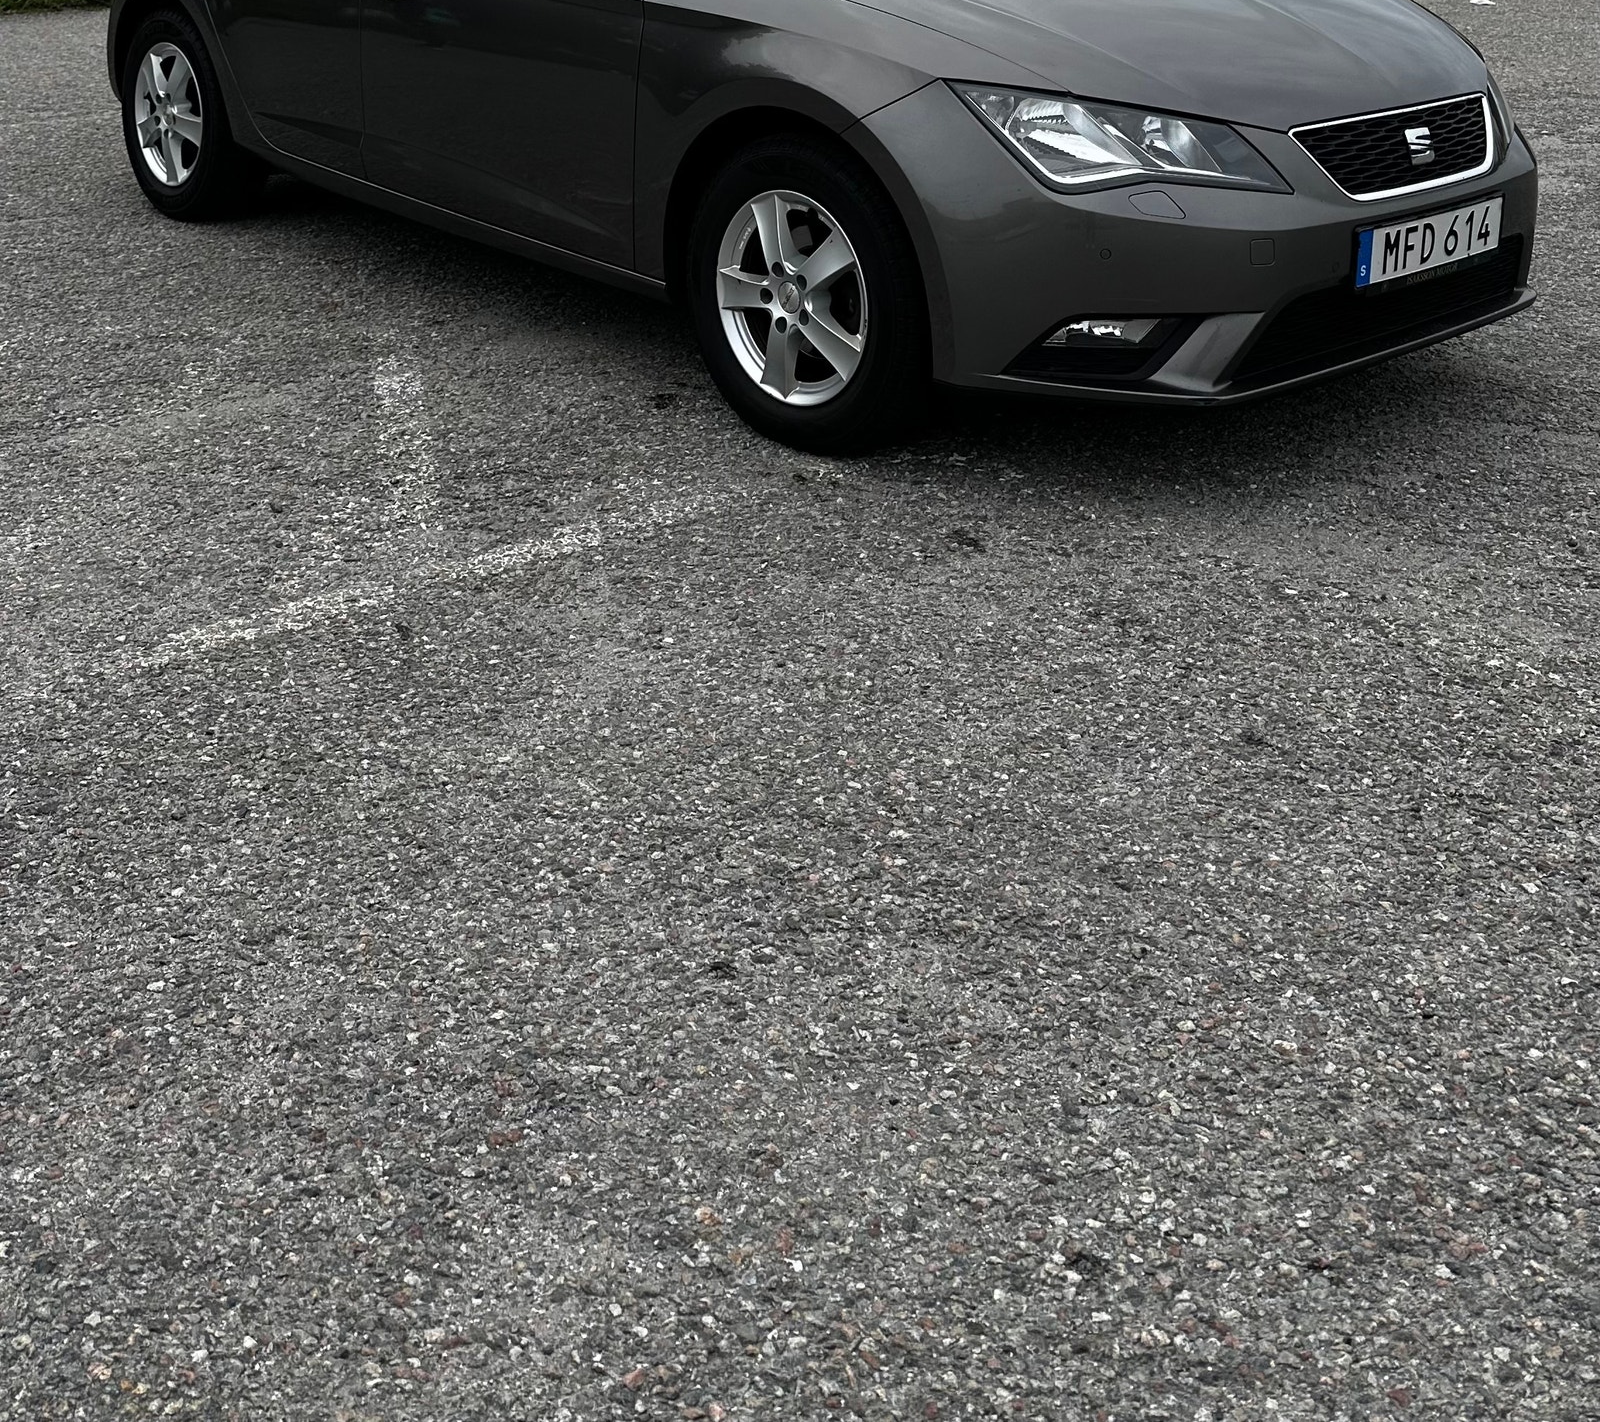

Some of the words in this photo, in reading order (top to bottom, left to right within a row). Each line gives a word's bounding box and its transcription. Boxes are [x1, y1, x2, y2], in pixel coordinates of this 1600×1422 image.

[1382, 222, 1436, 275] MFD
[1444, 205, 1490, 257] 614
[1360, 265, 1367, 277] S
